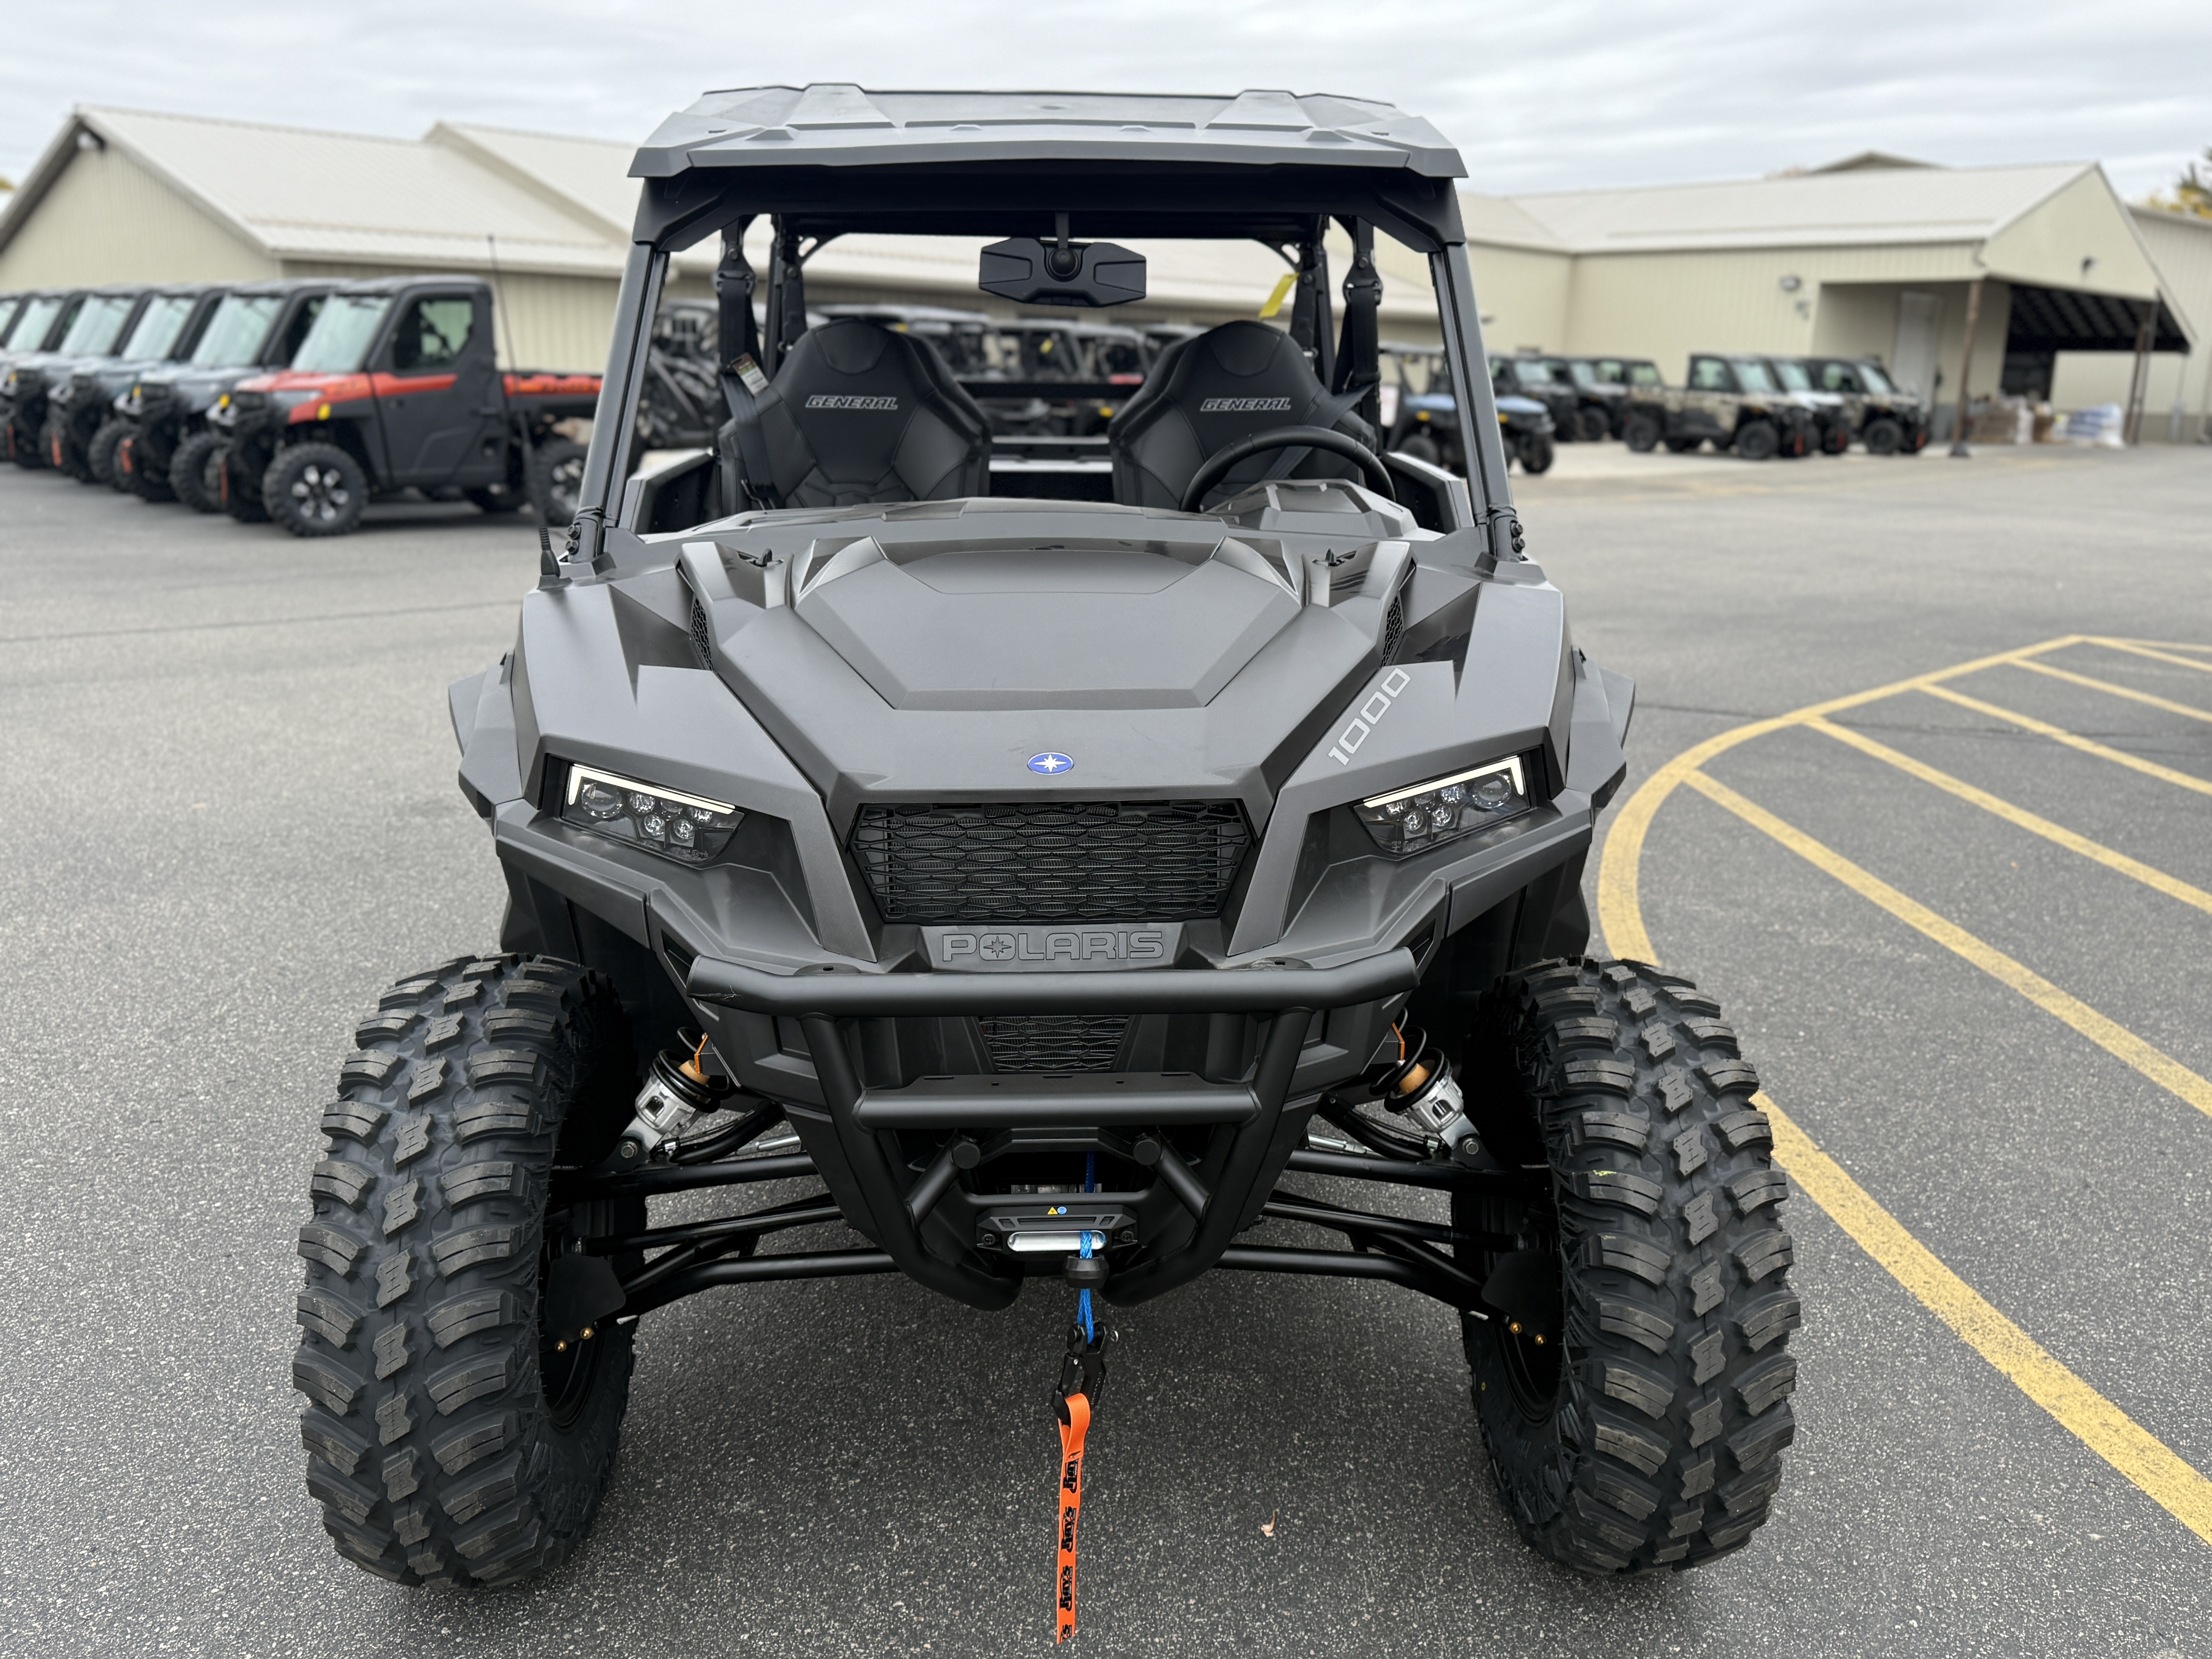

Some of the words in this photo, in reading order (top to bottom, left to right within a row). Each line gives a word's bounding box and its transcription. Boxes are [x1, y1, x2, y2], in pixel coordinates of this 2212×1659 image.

[805, 395, 898, 410] GENERAL
[1200, 397, 1291, 411] GENERAL
[1328, 668, 1410, 766] 1000
[942, 931, 1164, 962] POLARIS
